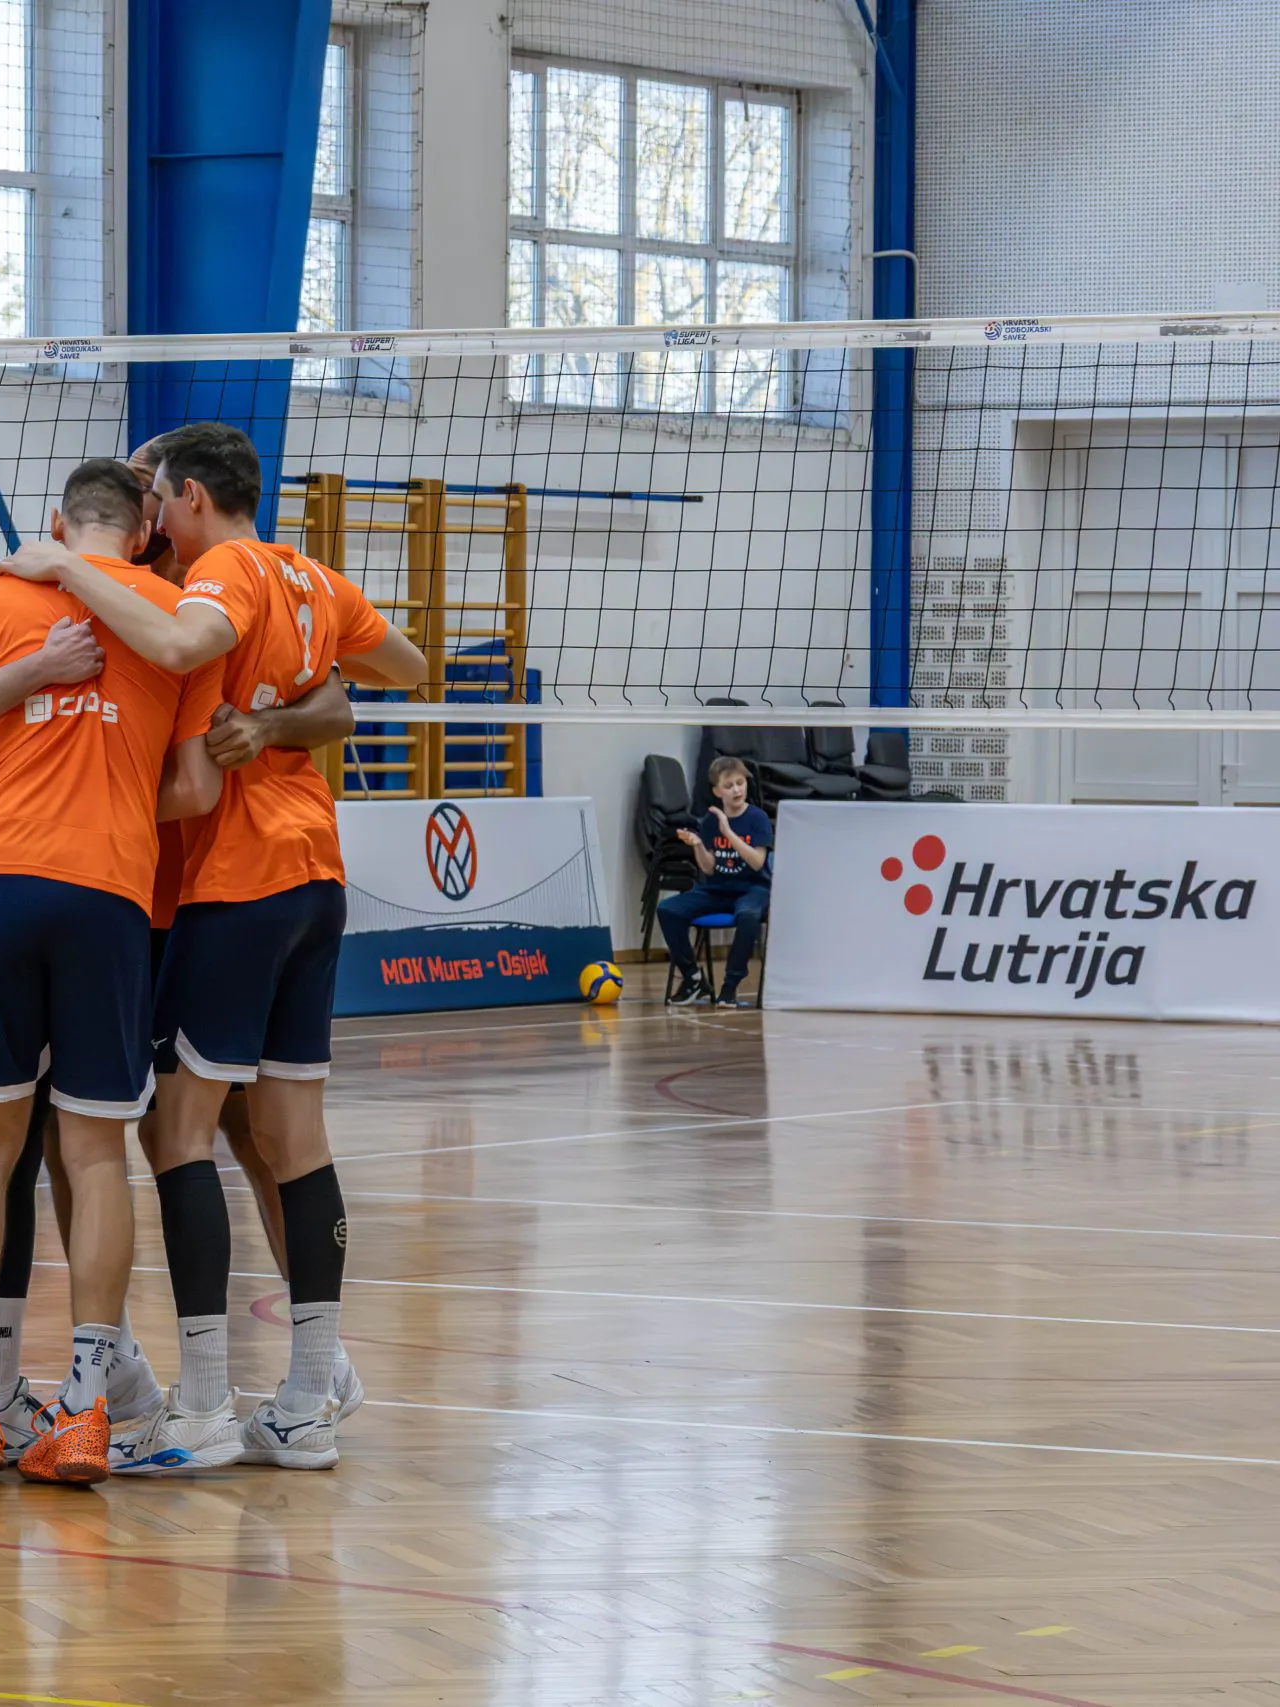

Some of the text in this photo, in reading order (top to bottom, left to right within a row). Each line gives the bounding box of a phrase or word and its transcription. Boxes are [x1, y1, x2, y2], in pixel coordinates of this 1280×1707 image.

[365, 336, 391, 344] SUPER
[679, 330, 706, 338] SUPER
[59, 352, 80, 360] SAVEZ
[941, 861, 1257, 920] Hrvatska
[380, 957, 427, 985] MOK
[427, 956, 484, 983] Mursa
[497, 949, 549, 982] Osijek
[922, 927, 1146, 999] Lutrija
[90, 1338, 108, 1367] nine
